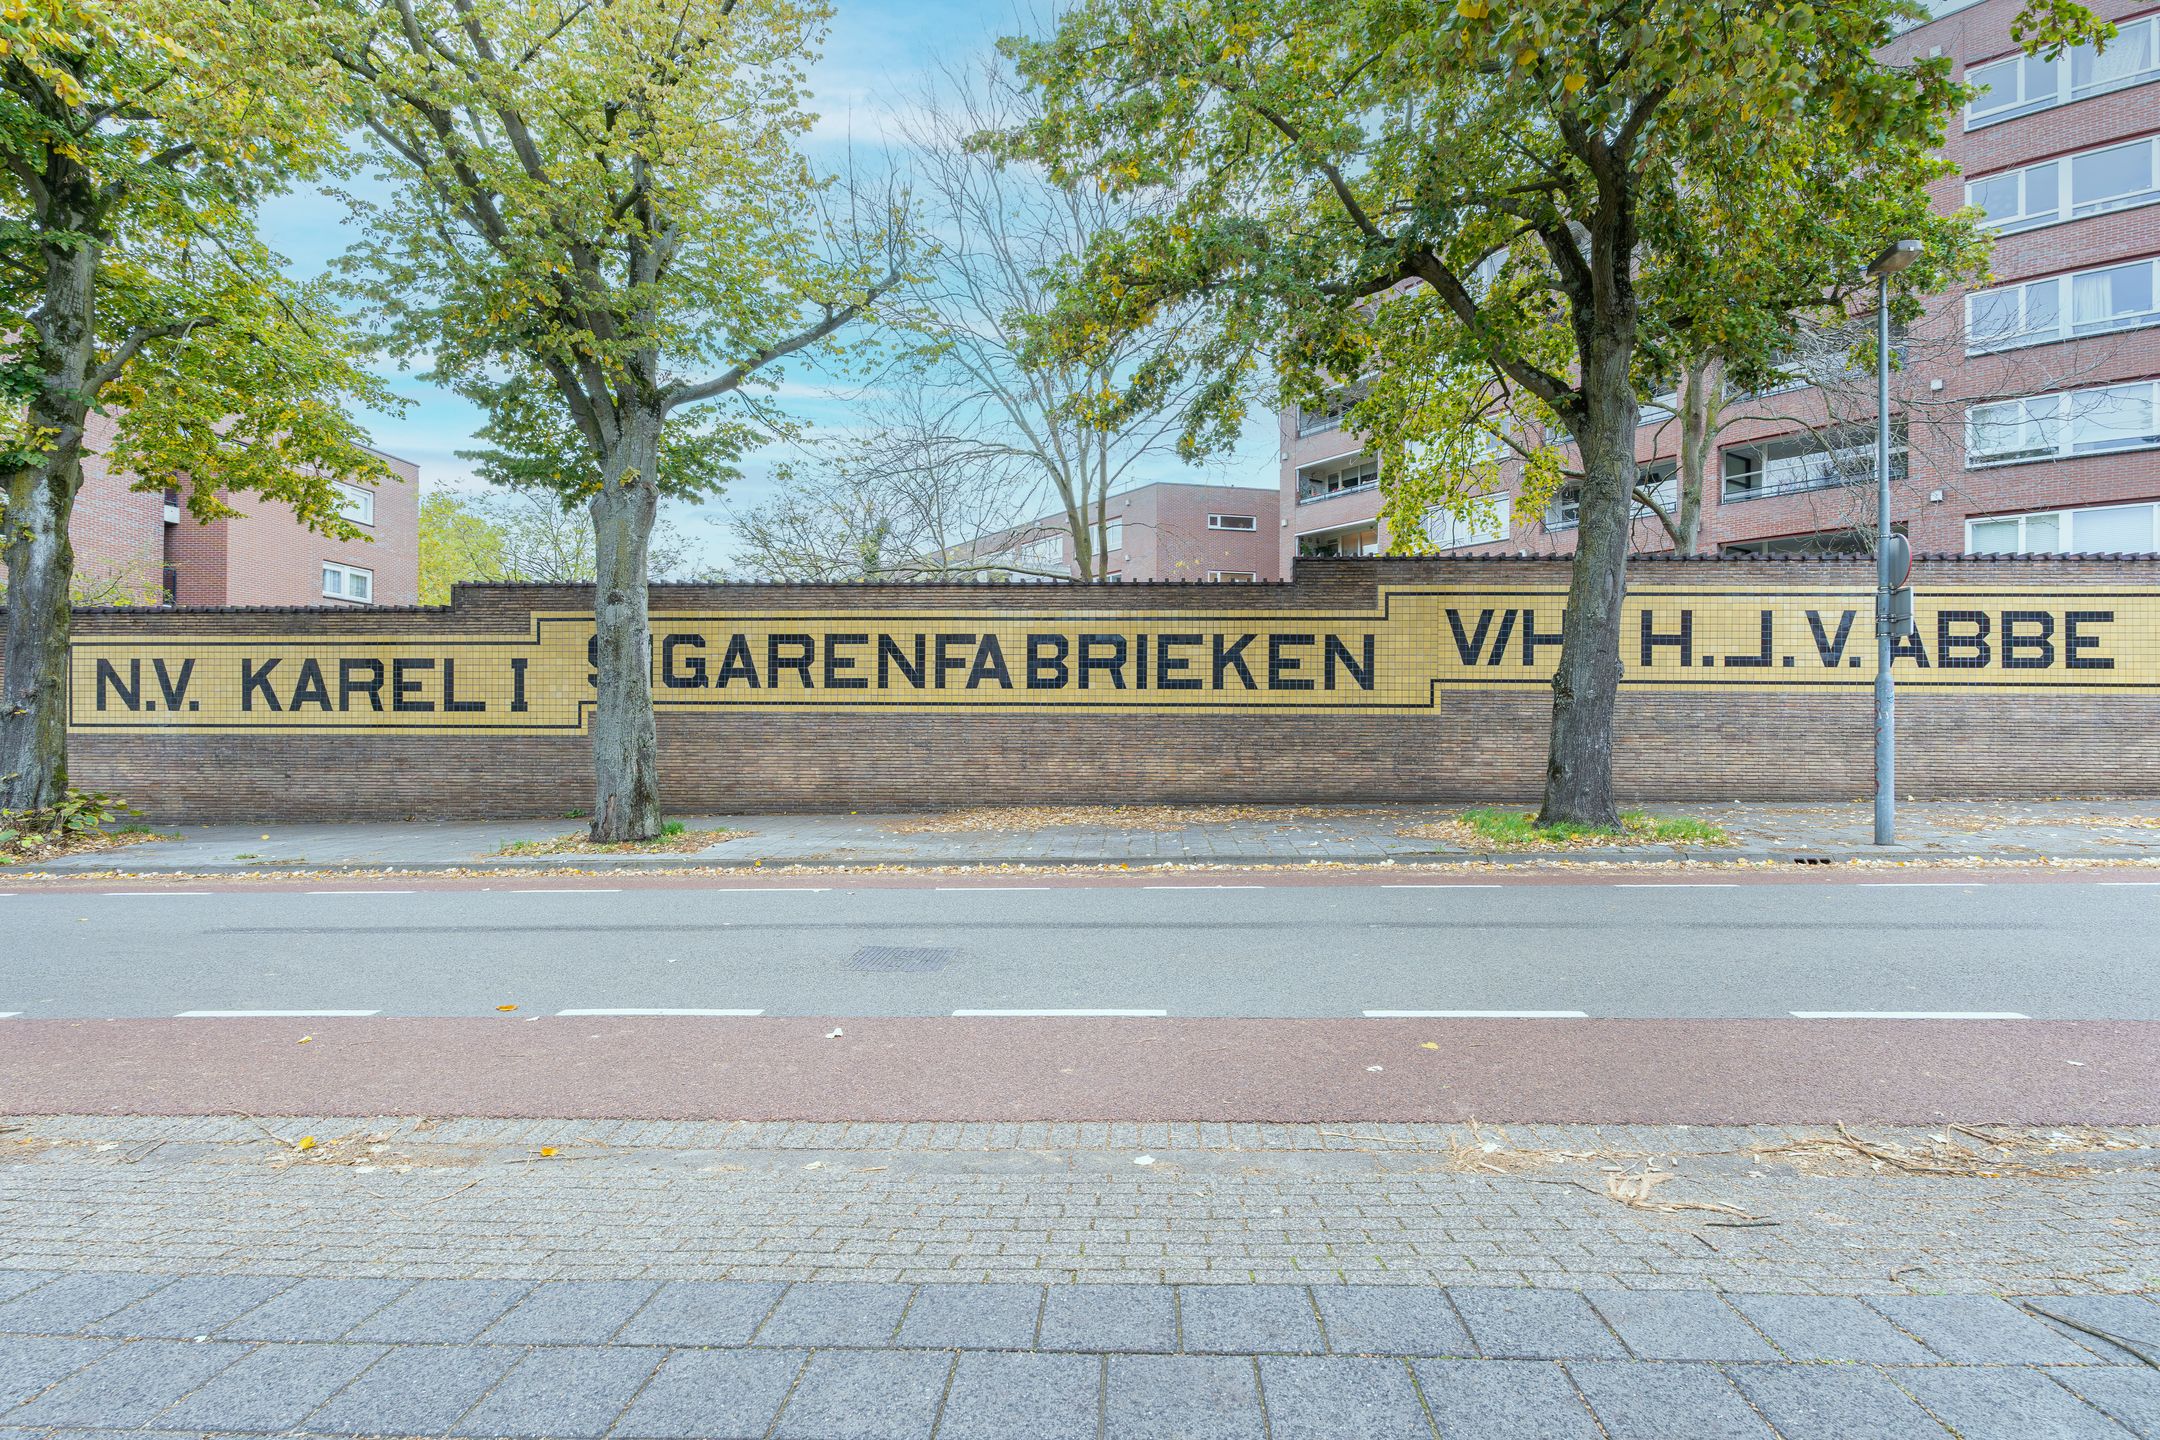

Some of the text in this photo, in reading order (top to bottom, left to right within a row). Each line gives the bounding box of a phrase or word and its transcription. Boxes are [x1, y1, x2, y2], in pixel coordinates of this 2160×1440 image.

[97, 658, 199, 711] N.V.
[242, 658, 485, 712] KAREL
[511, 658, 528, 712] I
[588, 634, 1374, 690] GARENFABRIEKEN
[1445, 609, 1568, 666] V/H
[1889, 611, 2115, 669] ABBE
